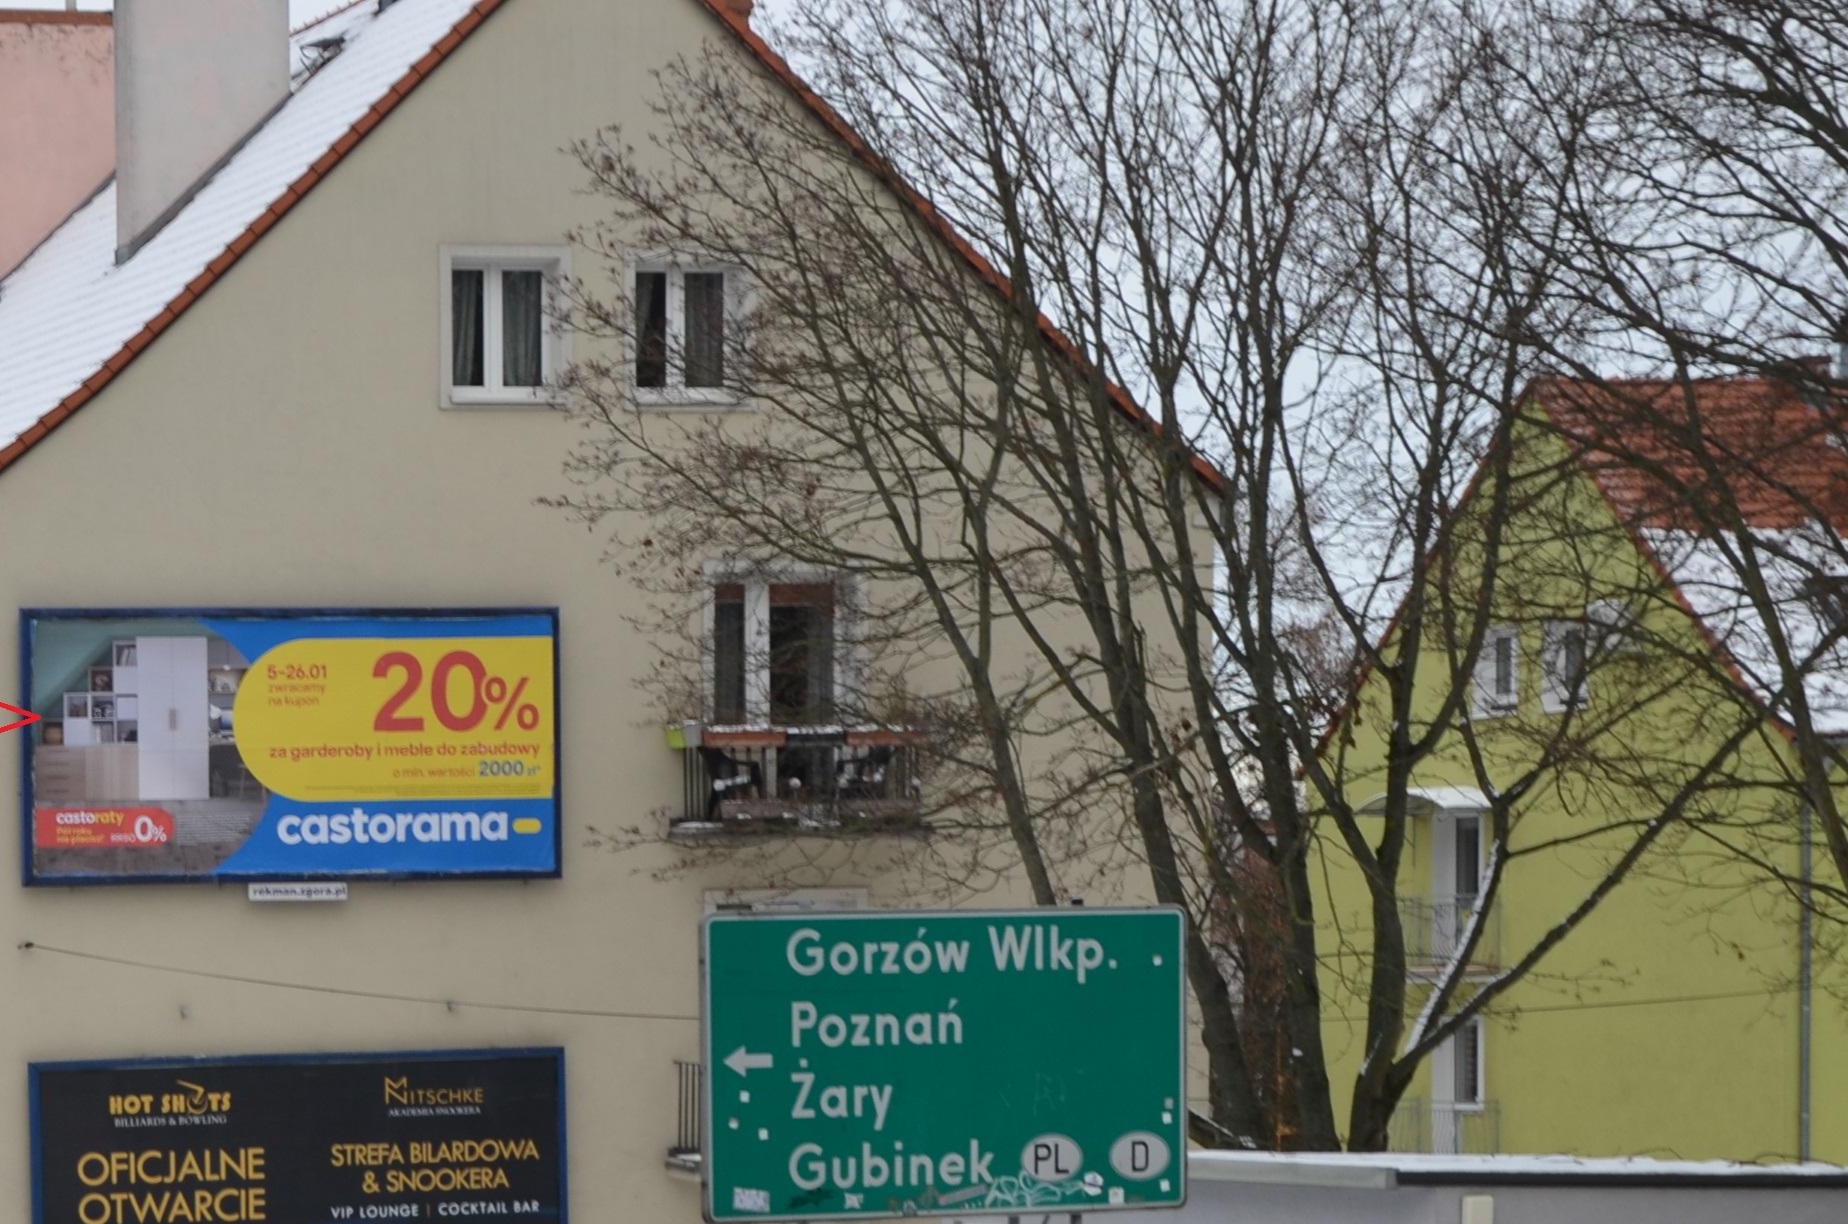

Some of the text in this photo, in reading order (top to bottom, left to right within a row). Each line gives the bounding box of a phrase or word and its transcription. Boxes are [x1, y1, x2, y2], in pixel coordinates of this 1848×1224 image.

[267, 664, 327, 680] 5-26.01
[372, 650, 540, 732] 20%
[269, 742, 540, 762] za garderoby i meble do zabudowy
[479, 760, 524, 777] 2000
[56, 811, 124, 826] castoraty
[135, 815, 167, 842] 0%
[277, 808, 508, 845] castorama
[786, 924, 1118, 984] Gorzów Wlkp.
[791, 998, 963, 1048] Poznań
[109, 1095, 154, 1115] HOT
[791, 1057, 894, 1131] Żary
[114, 1114, 227, 1128] BILLIARDS & BOWLING
[331, 1138, 540, 1167] STREFA BILARDOWA
[789, 1138, 994, 1191] Gubinek
[1034, 1144, 1069, 1175] PL
[1131, 1141, 1150, 1173] D
[77, 1147, 266, 1187] OFICJALNE
[362, 1167, 510, 1194] & SNOOKERA
[330, 1206, 353, 1219] VIP
[359, 1203, 419, 1218] LOUNGE
[438, 1201, 508, 1216] COCKTAIL
[513, 1199, 540, 1213] BAR
